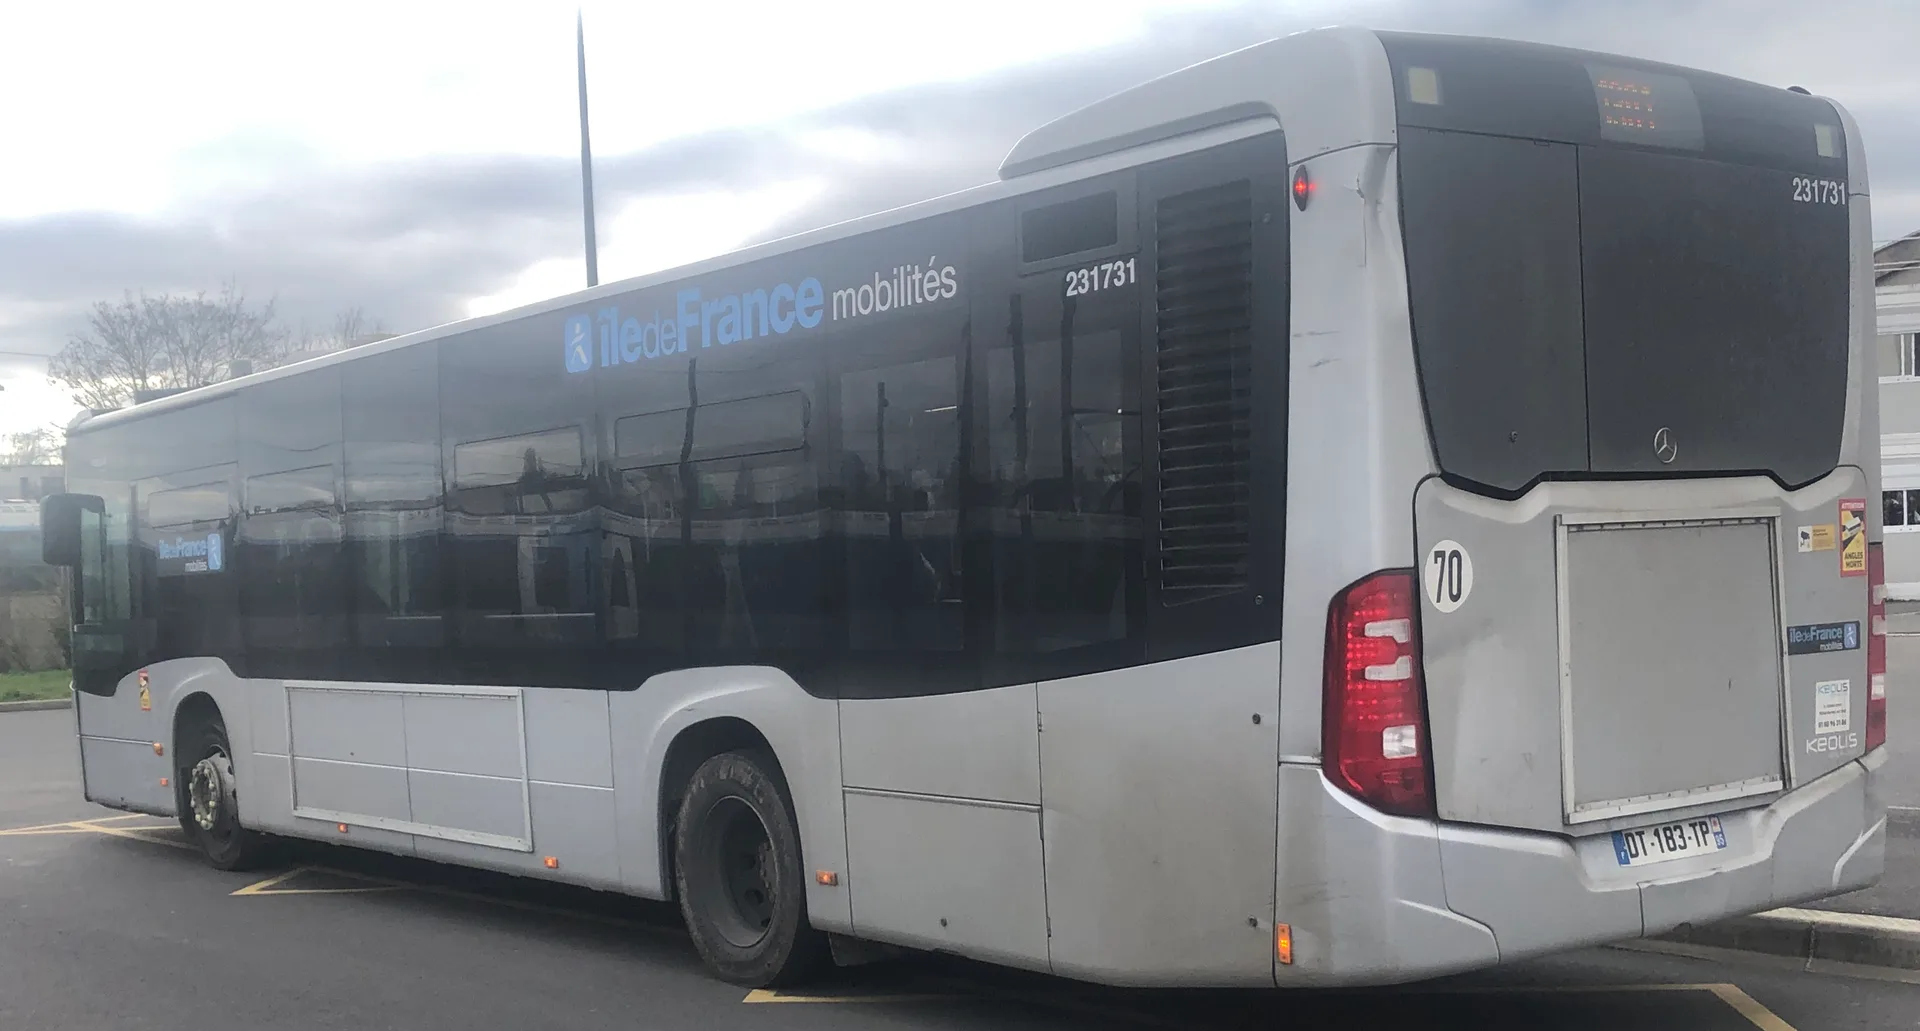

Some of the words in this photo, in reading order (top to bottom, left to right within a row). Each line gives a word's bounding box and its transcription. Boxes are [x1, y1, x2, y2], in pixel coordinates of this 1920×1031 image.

[1792, 177, 1846, 205] 231731
[832, 256, 957, 320] mobilités
[1066, 258, 1136, 297] 231731
[1844, 551, 1864, 560] ANGLES
[1845, 560, 1863, 568] MORTS
[1433, 549, 1463, 604] 70
[1624, 820, 1710, 859] DT-183-TP
